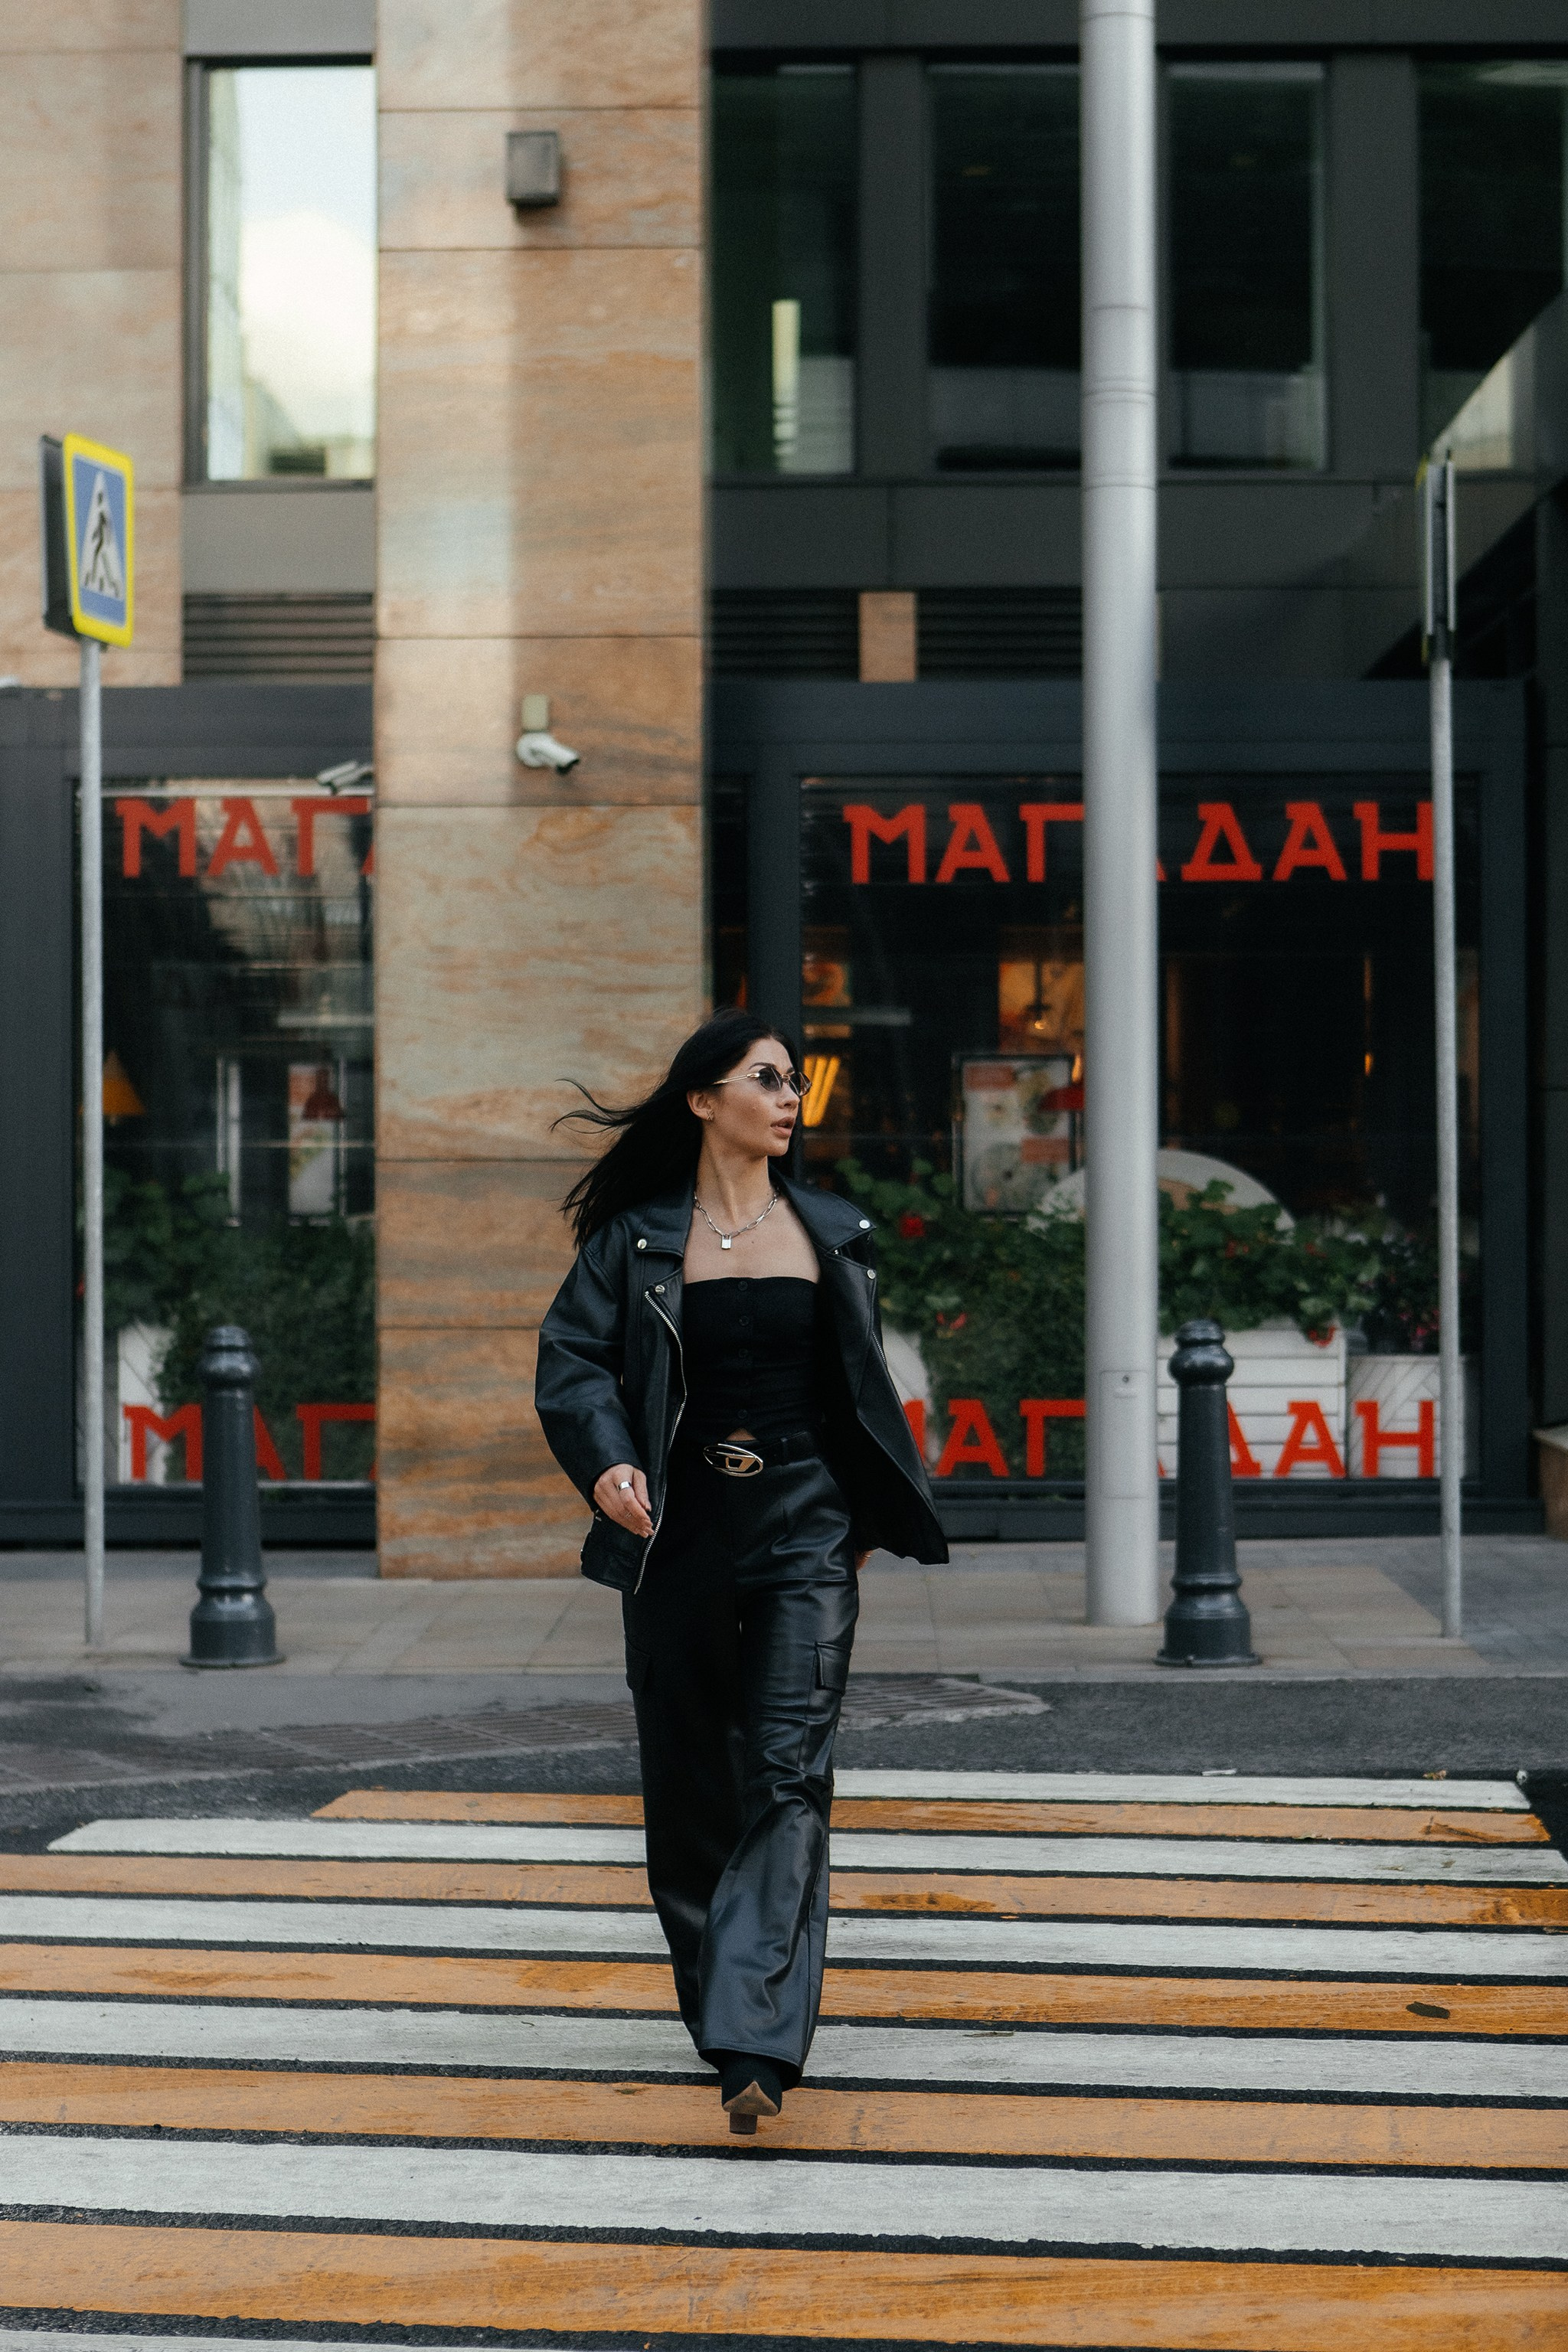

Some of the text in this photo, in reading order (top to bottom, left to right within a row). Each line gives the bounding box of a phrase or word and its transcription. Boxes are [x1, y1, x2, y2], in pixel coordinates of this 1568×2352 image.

[116, 798, 374, 877] МАГ
[843, 802, 1434, 883] МАГДАН
[902, 1399, 1435, 1478] АГАН
